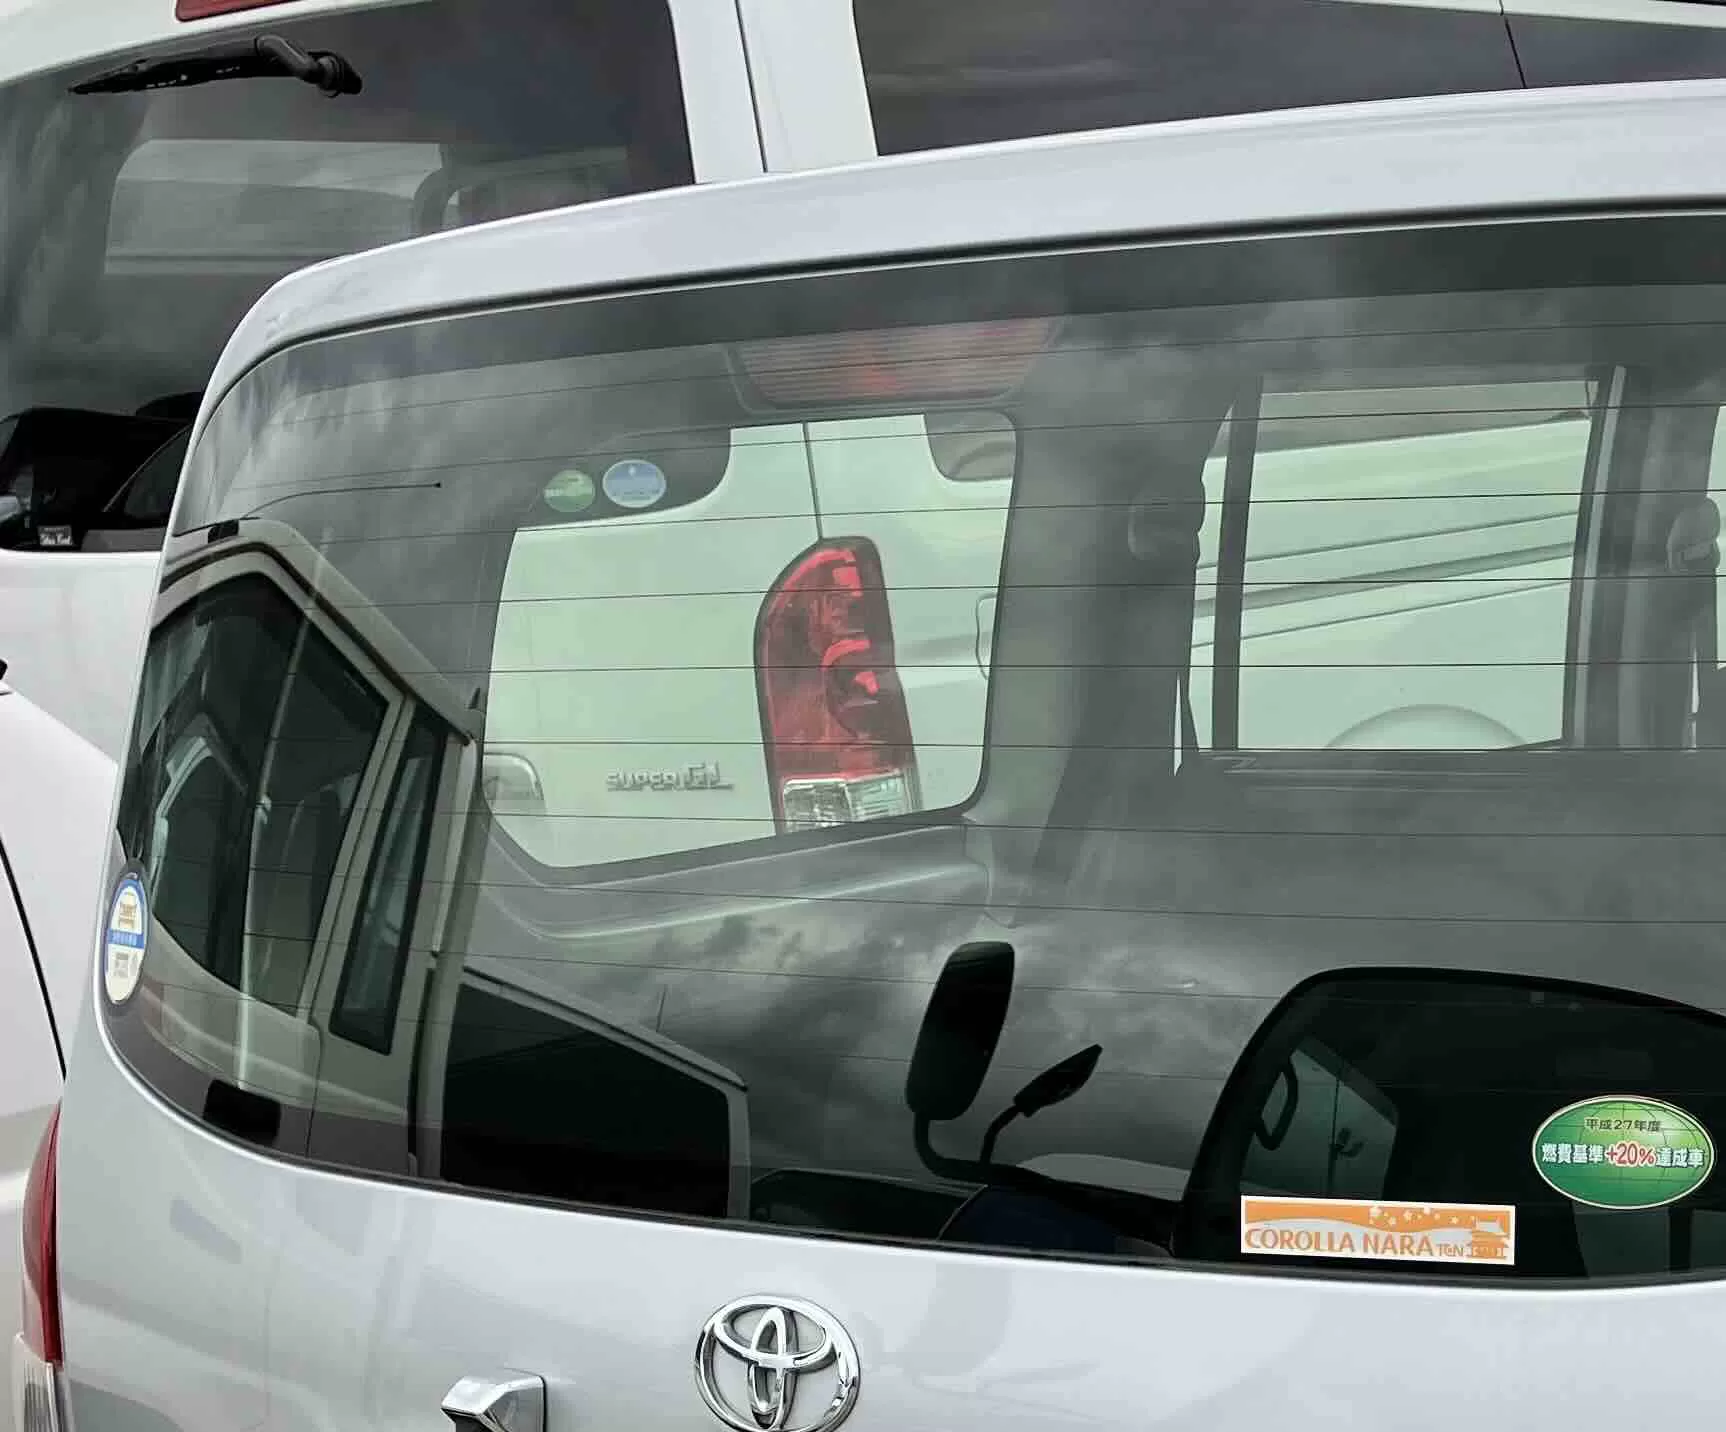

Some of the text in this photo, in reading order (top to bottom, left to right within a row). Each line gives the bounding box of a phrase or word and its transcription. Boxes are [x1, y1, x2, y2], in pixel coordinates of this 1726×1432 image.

[1585, 1118, 1662, 1132] 平成27年度
[1245, 1228, 1358, 1253] COROLLA
[1363, 1232, 1435, 1257] NARA
